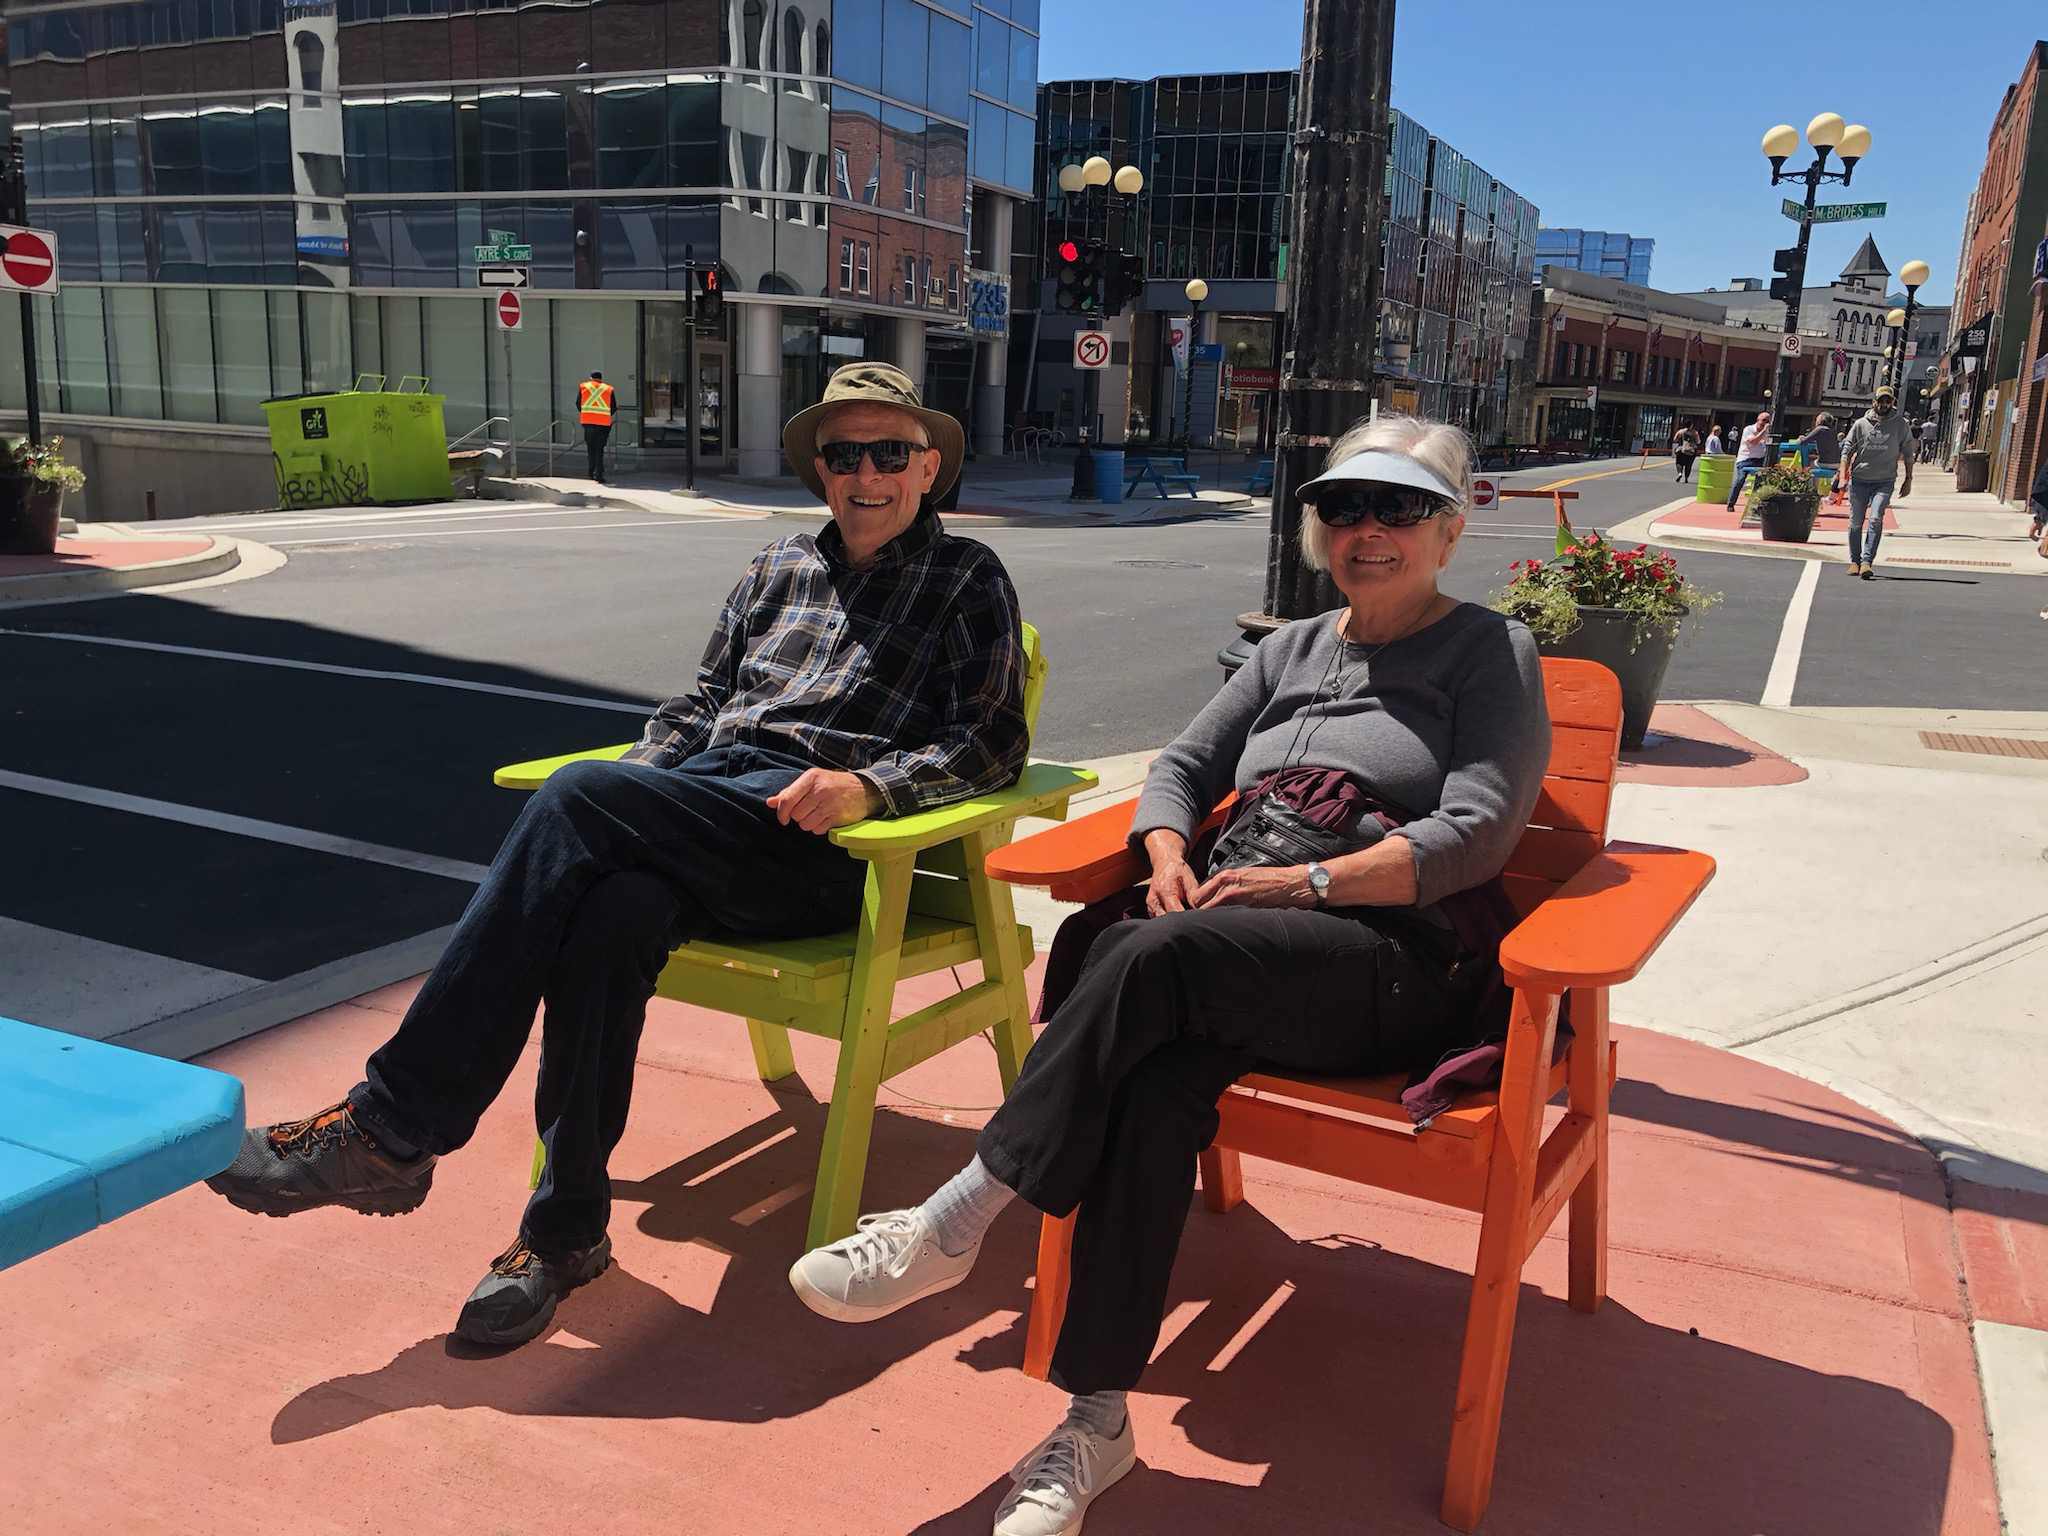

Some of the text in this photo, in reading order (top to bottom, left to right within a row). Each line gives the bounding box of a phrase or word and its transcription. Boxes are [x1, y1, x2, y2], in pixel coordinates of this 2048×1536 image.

[1867, 206, 1884, 217] HILL
[479, 247, 511, 260] AYRES
[972, 280, 1008, 315] 235
[1967, 329, 1986, 338] 250
[1230, 374, 1275, 385] otiabank
